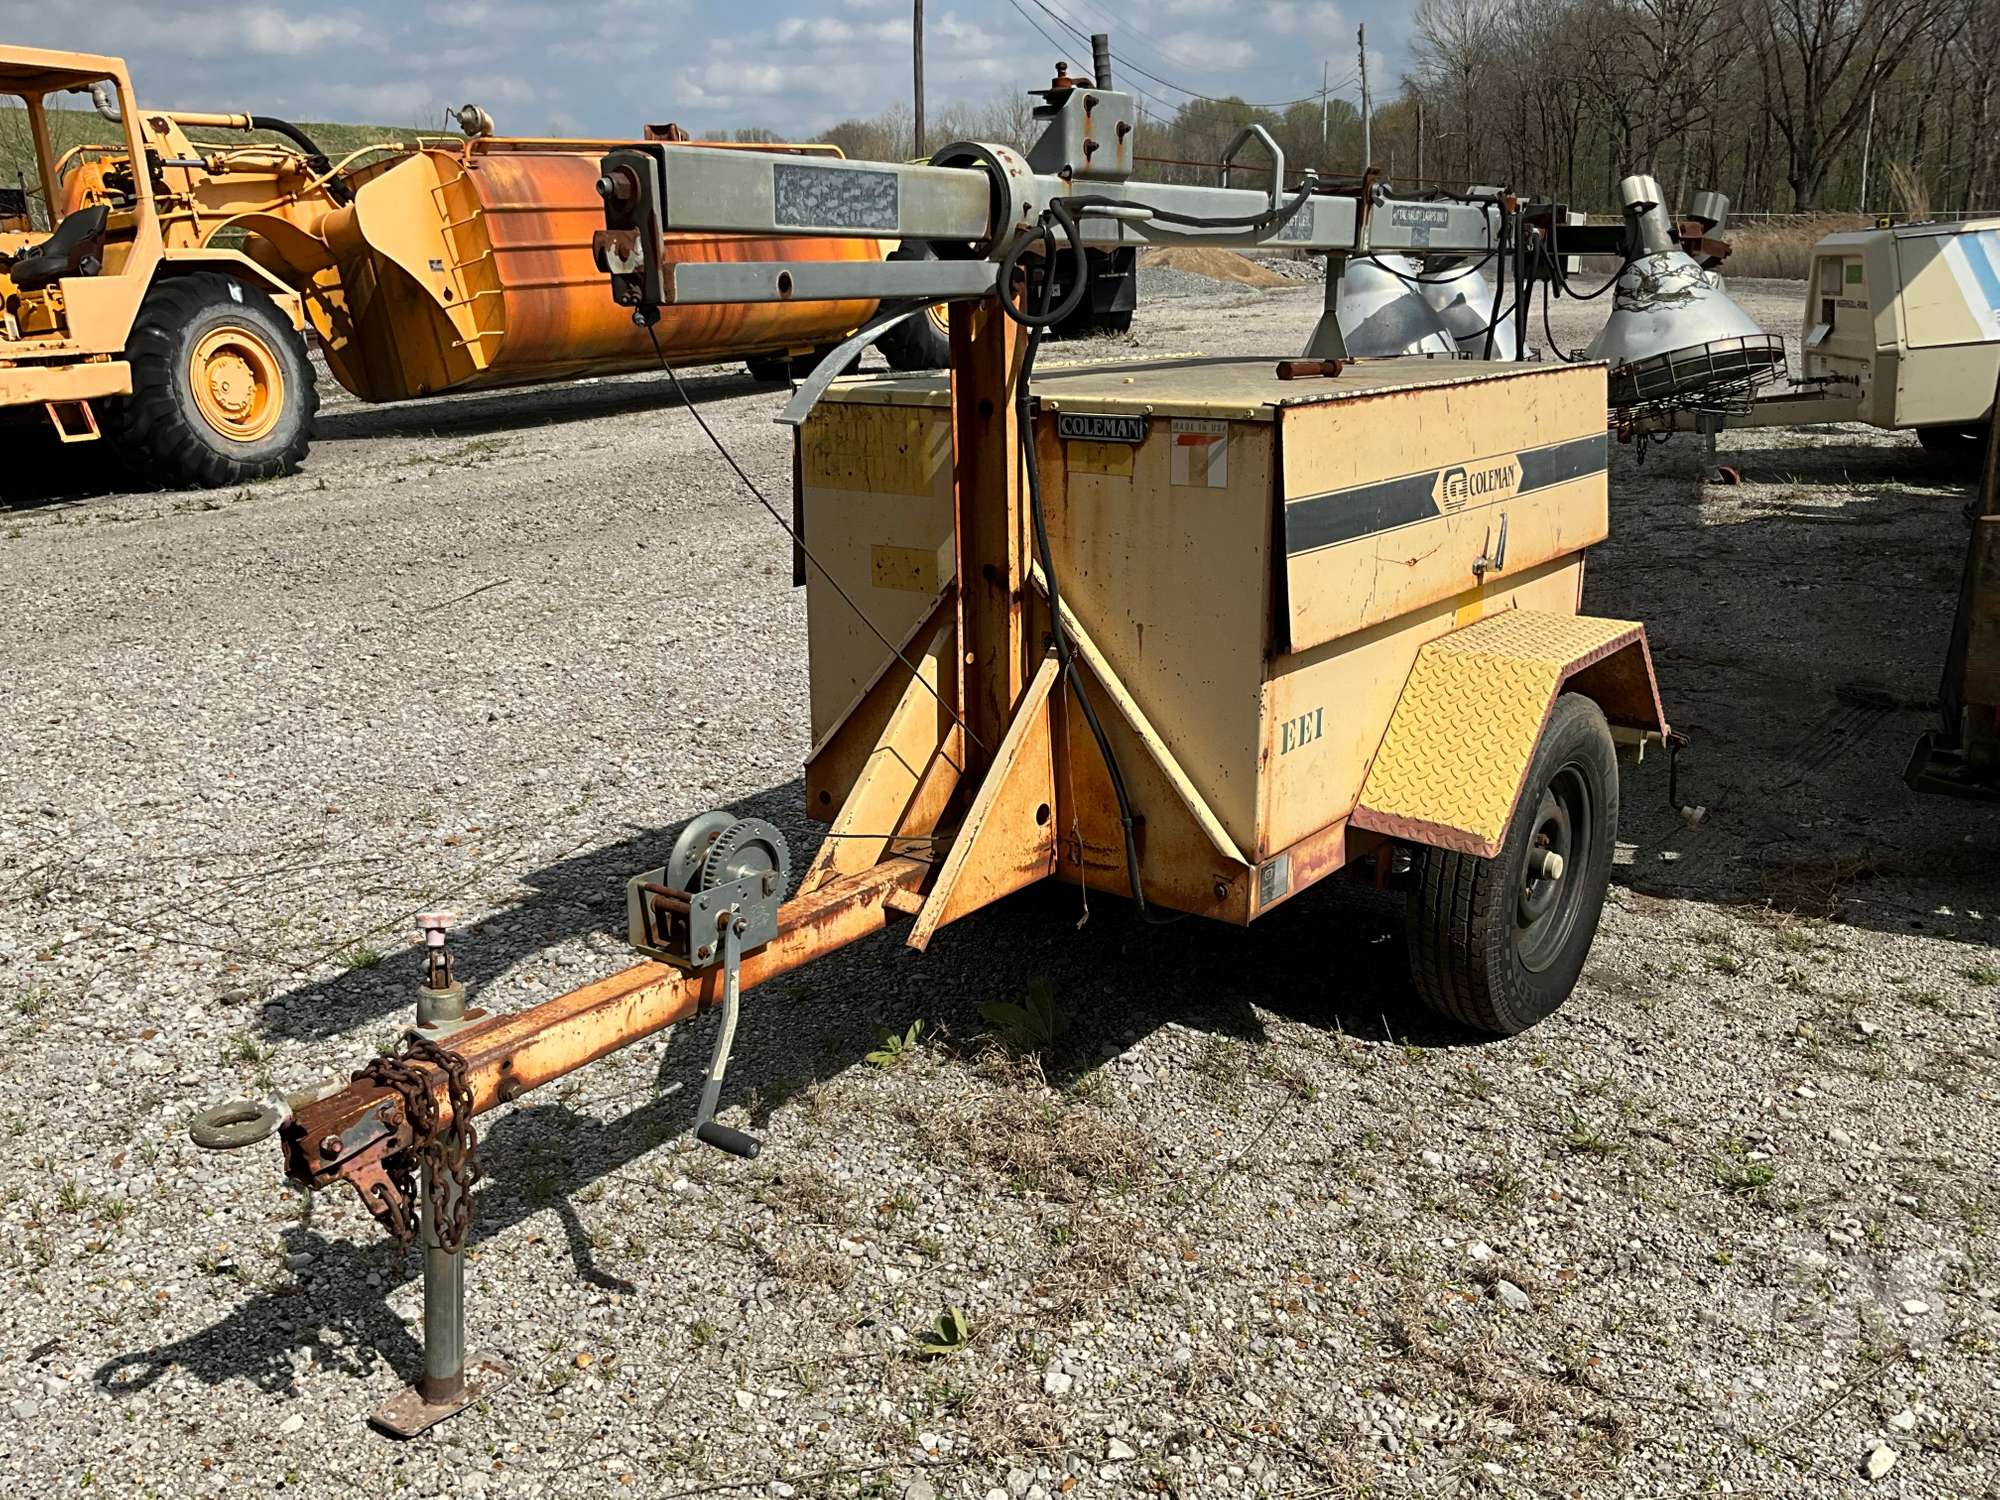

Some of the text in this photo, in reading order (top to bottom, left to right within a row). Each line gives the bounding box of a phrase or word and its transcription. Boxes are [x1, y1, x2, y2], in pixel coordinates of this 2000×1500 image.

[1061, 417, 1139, 438] COLEMAN
[1469, 465, 1515, 496] COLEMAN
[1281, 706, 1323, 755] EEI
